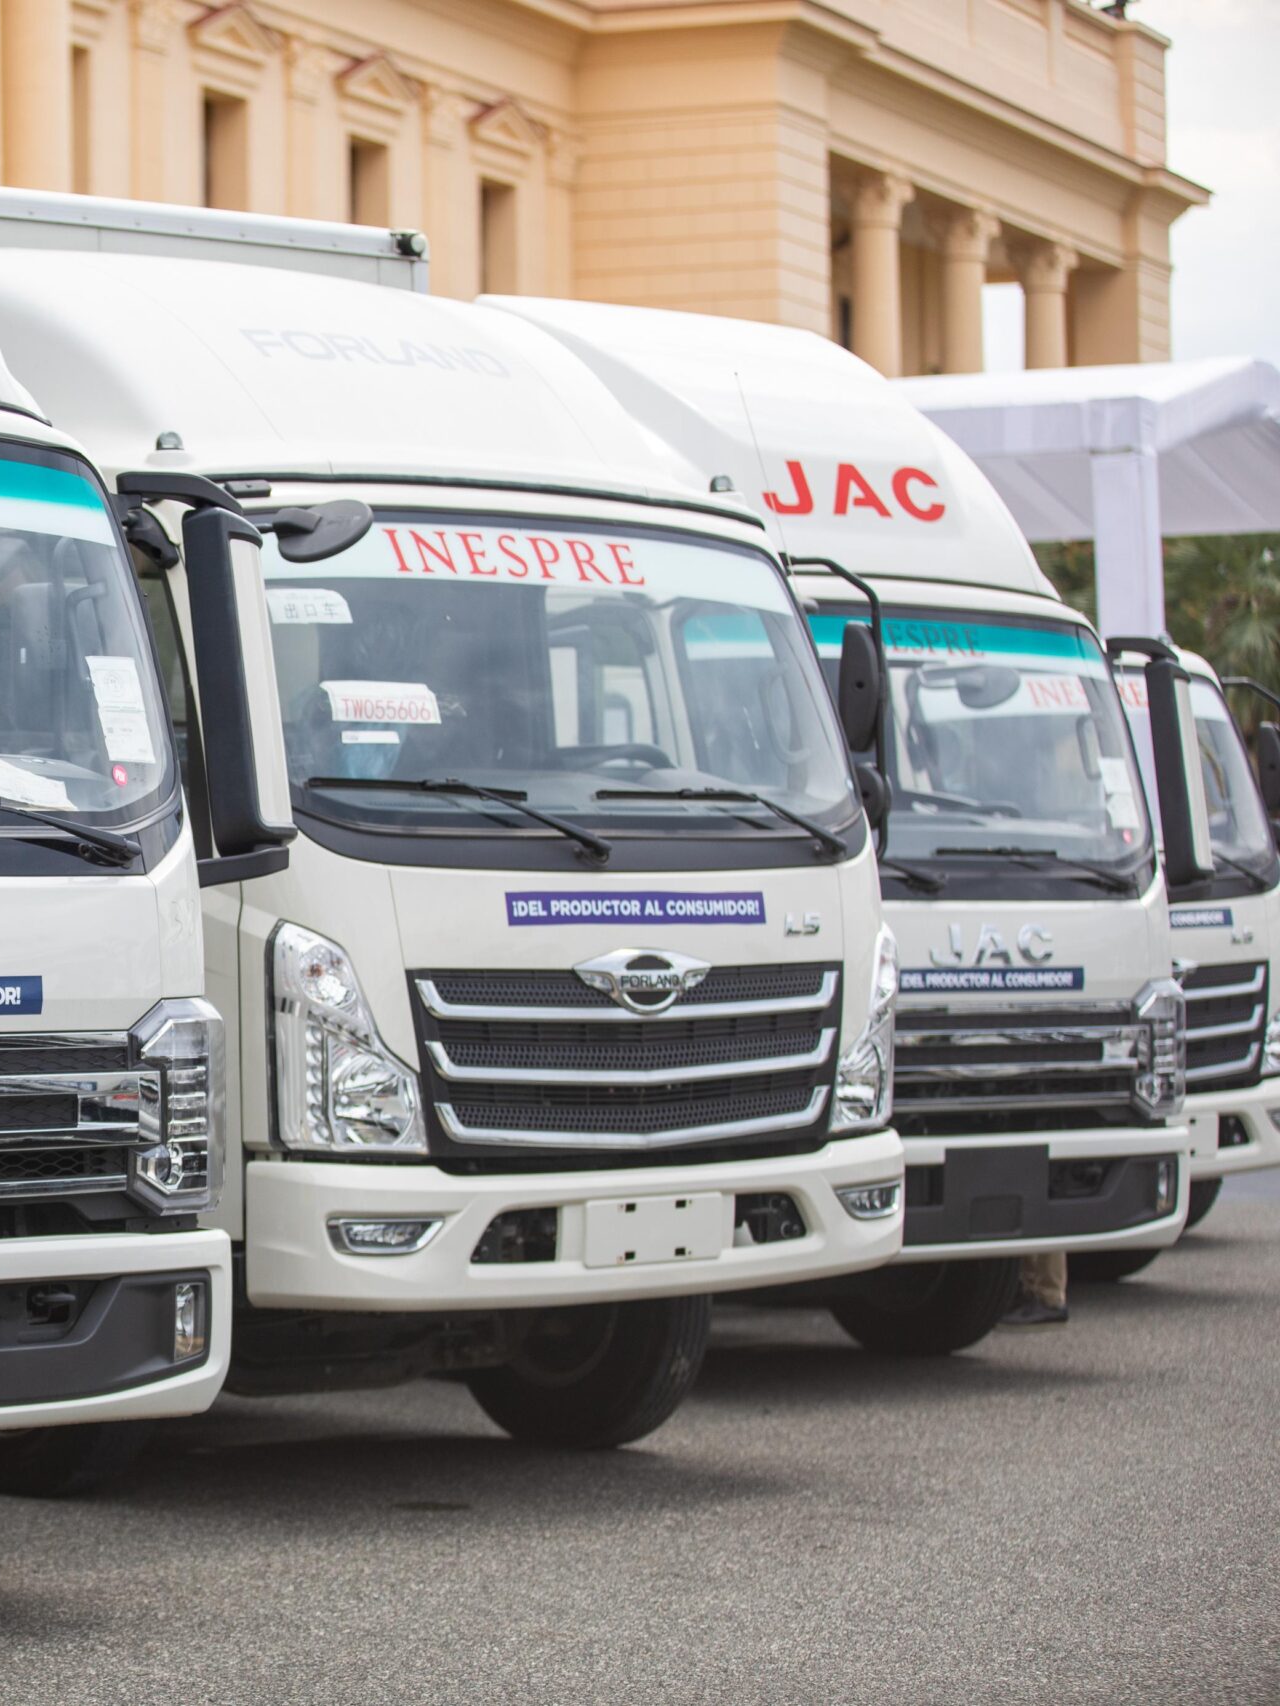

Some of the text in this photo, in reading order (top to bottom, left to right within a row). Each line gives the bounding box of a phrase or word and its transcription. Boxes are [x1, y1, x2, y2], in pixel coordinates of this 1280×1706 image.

[239, 329, 511, 378] FORLAND
[762, 460, 945, 522] JAC
[383, 529, 645, 586] INESPRE
[341, 698, 431, 721] TW055606
[513, 899, 759, 918] ¡DEL PRODUCTOR AL CONSUMIDOR!
[929, 923, 1053, 968] JAC
[621, 974, 680, 988] FORLAND
[926, 972, 990, 988] PRODUCTOR
[991, 972, 1006, 987] AL
